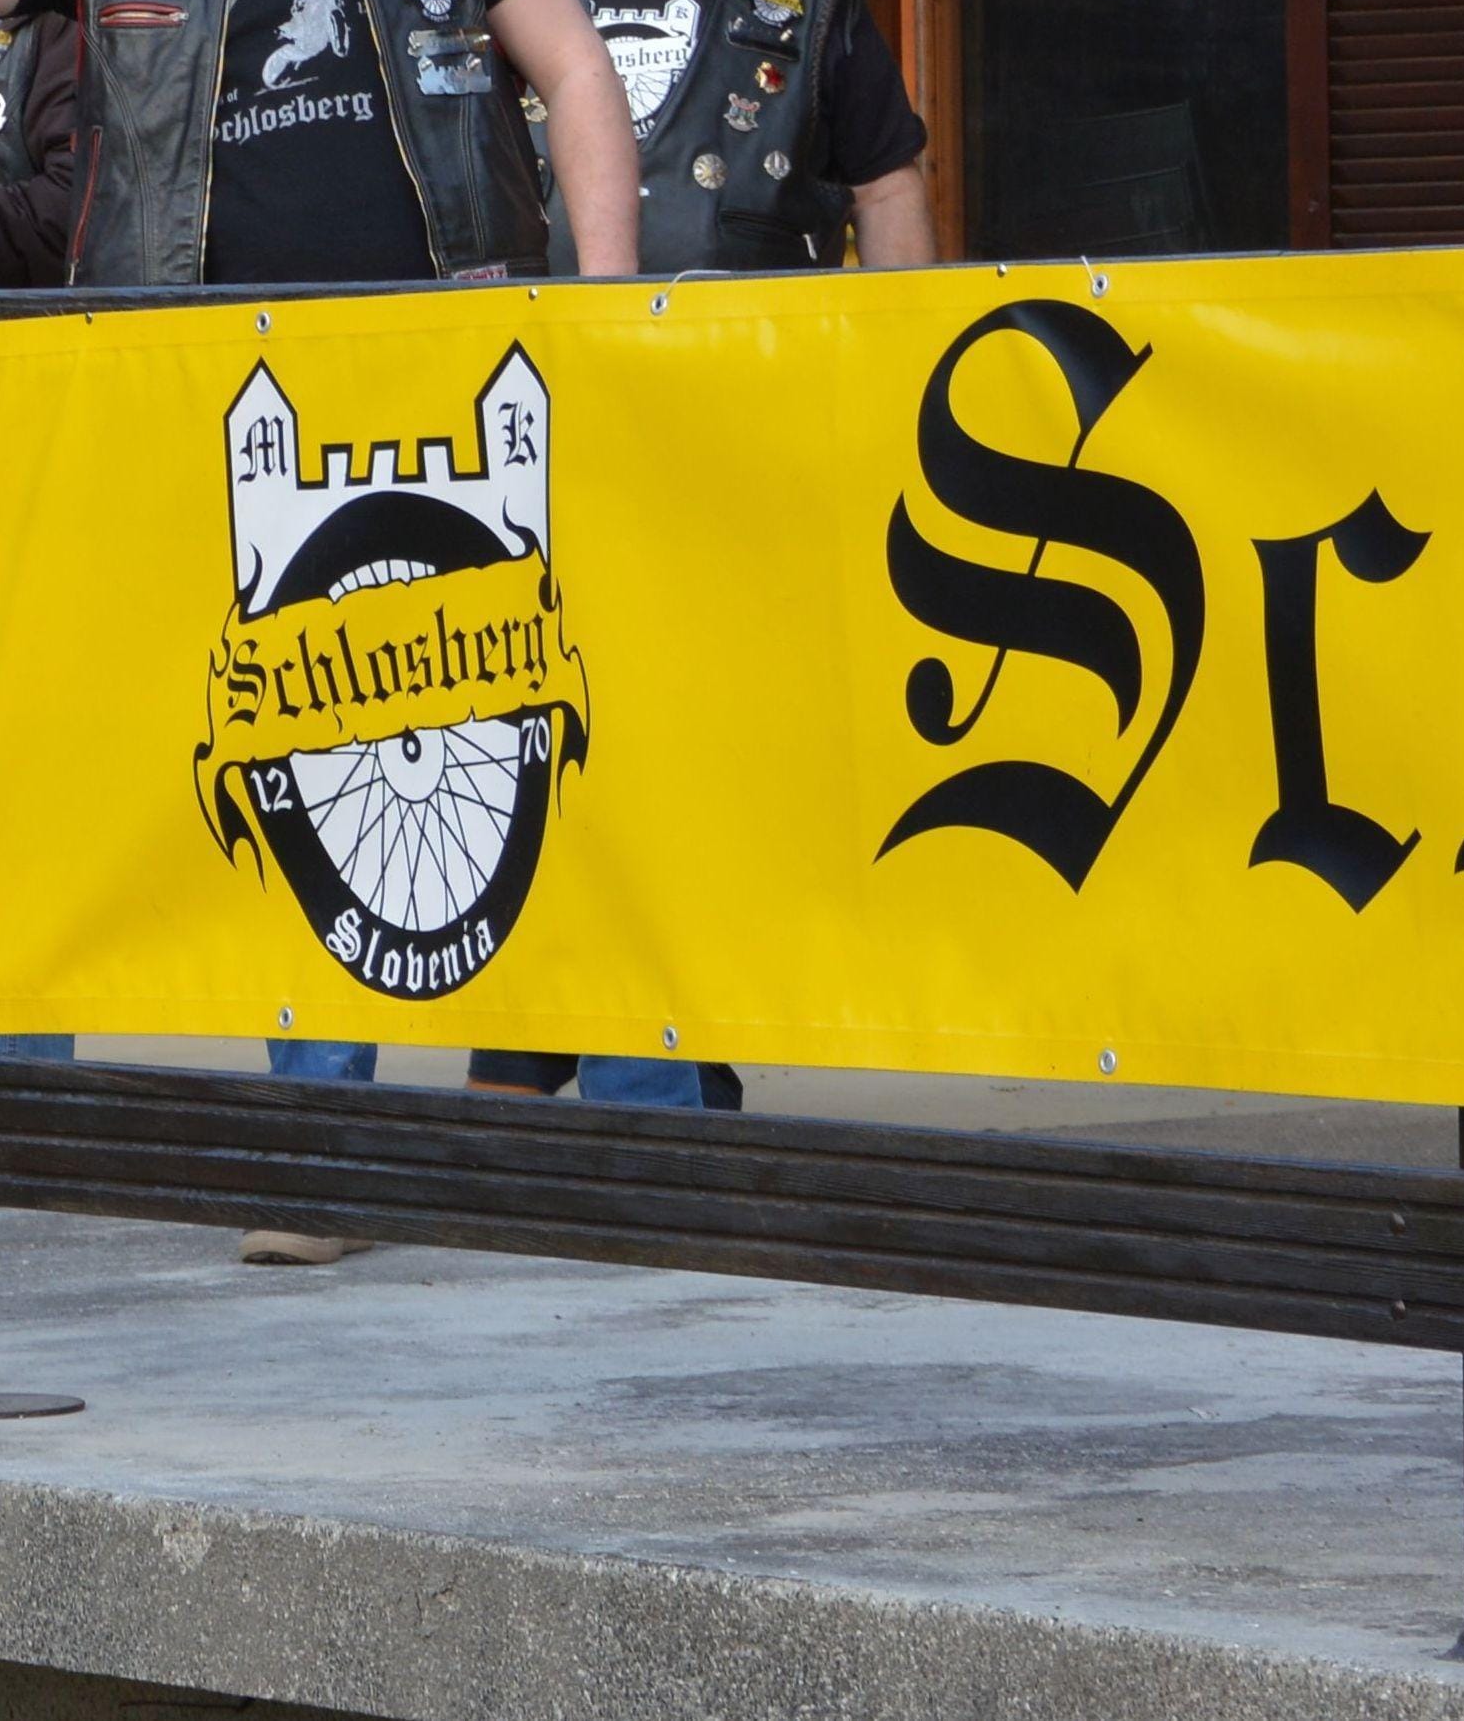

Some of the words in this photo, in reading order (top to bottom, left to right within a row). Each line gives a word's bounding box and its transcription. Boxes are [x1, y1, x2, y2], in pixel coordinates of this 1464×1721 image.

[226, 88, 238, 103] of
[237, 415, 289, 484] M
[224, 606, 549, 735] Schlosberg
[519, 717, 552, 766] 70
[250, 767, 294, 814] 12
[326, 907, 496, 993] Slovenia
